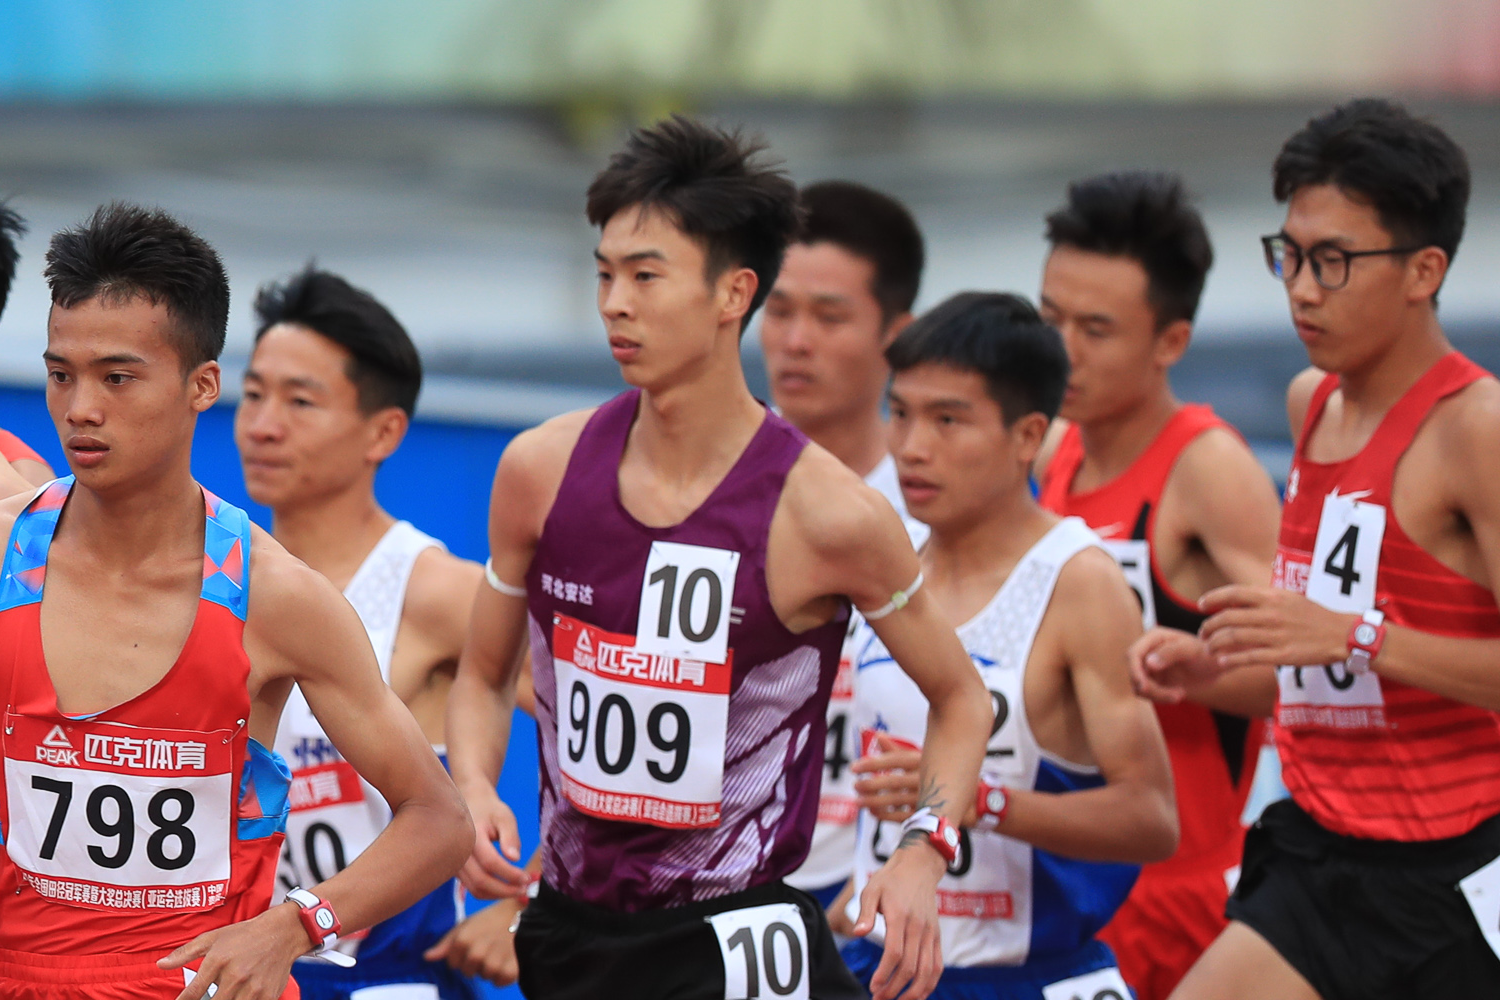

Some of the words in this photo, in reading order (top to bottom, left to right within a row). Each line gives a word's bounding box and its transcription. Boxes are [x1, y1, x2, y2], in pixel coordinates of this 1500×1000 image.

[1324, 524, 1360, 596] 4
[649, 565, 722, 643] 10
[597, 641, 706, 686] 匹克体育
[36, 745, 81, 766] PEAK
[84, 734, 206, 770] 匹克体育
[568, 680, 691, 783] 909
[32, 775, 196, 870] 798
[727, 922, 802, 998] 10
